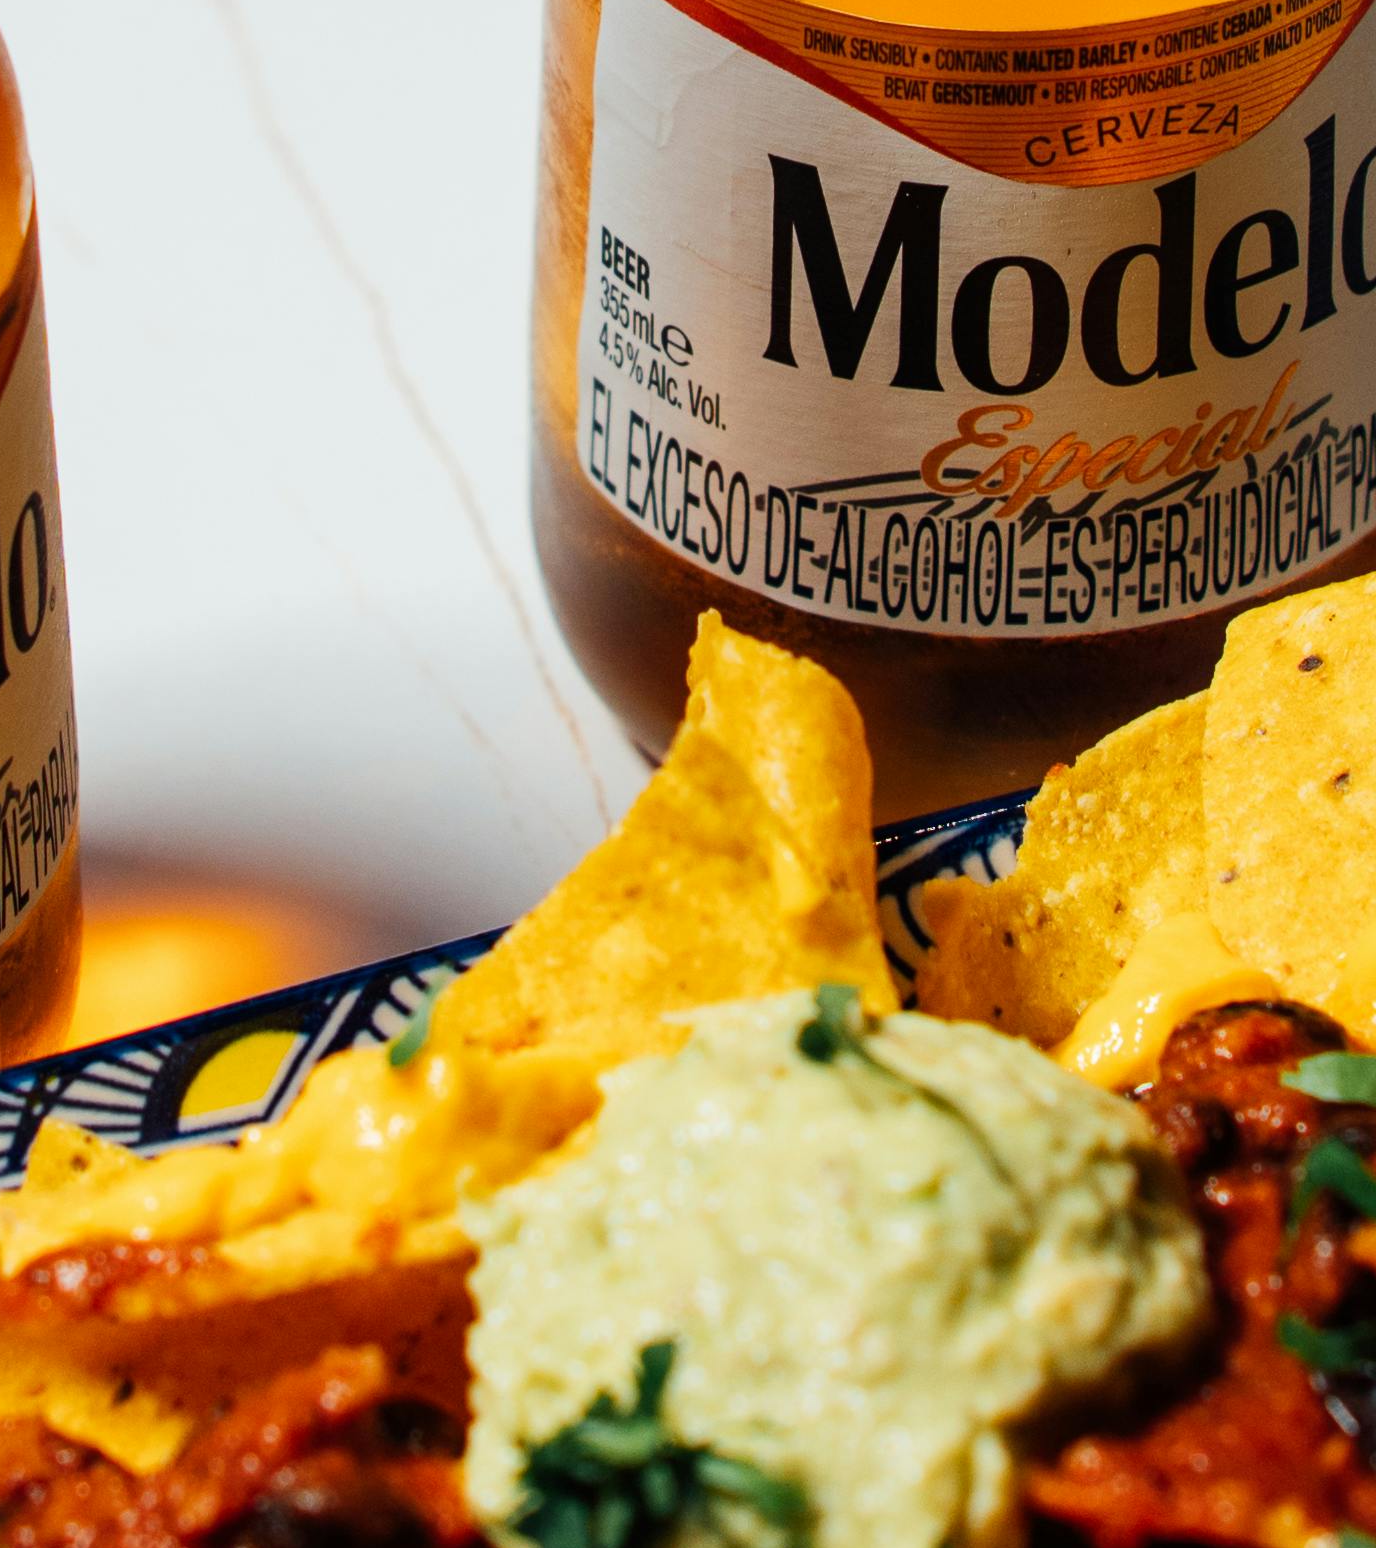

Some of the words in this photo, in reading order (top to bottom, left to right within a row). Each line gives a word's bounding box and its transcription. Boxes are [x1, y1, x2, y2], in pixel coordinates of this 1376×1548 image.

[802, 27, 846, 56] DRINK
[850, 37, 918, 68] SENSIBLY
[935, 48, 1008, 73] CONTAINS
[1012, 47, 1074, 73] MALTED
[1078, 40, 1138, 69] BARLEY
[1154, 20, 1219, 59] CONTIENE
[1222, 2, 1273, 41] CEBADA
[883, 75, 930, 103] BEVAT
[932, 82, 1038, 106] GERSTEMOUT
[1054, 79, 1087, 104] BEVI
[1199, 39, 1261, 81] CONTIENE
[1262, 22, 1303, 59] MALTO
[1024, 102, 1241, 169] CERVEZA
[600, 224, 651, 301] BEER
[599, 275, 631, 330] 355
[647, 358, 684, 411] Alc.
[687, 379, 728, 432] Vol.
[920, 359, 1302, 520] Especial
[589, 376, 618, 498] EL
[625, 408, 751, 576] EXCESO
[763, 483, 819, 601] DE
[824, 501, 1029, 627] ALCOHOL
[1043, 515, 1098, 625] ES
[1110, 444, 1342, 618] PERJUDICIAL
